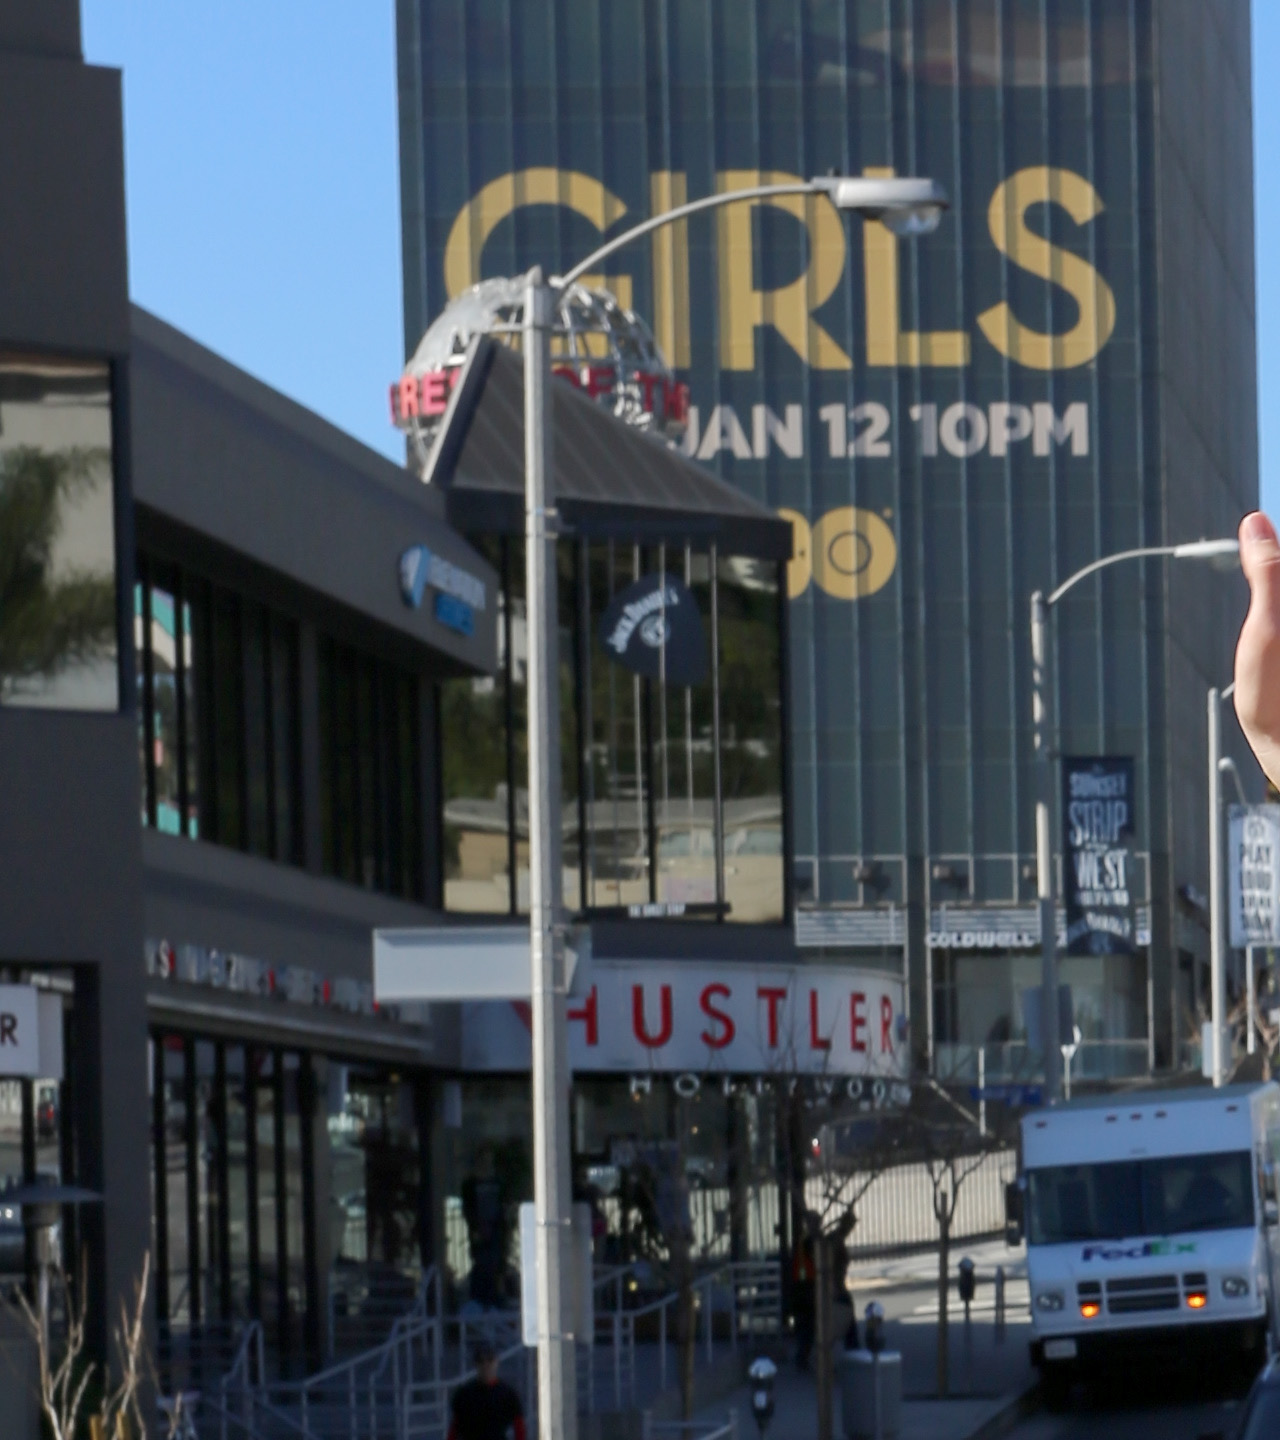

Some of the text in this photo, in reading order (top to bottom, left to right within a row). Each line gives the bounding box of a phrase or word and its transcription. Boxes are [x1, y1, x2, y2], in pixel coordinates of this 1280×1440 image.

[444, 166, 1116, 371] GIRLS
[681, 402, 1090, 460] JAN 12 10PM
[1069, 800, 1128, 846] STRIP
[1075, 848, 1128, 890] WEST
[1082, 1238, 1196, 1262] FedEx
